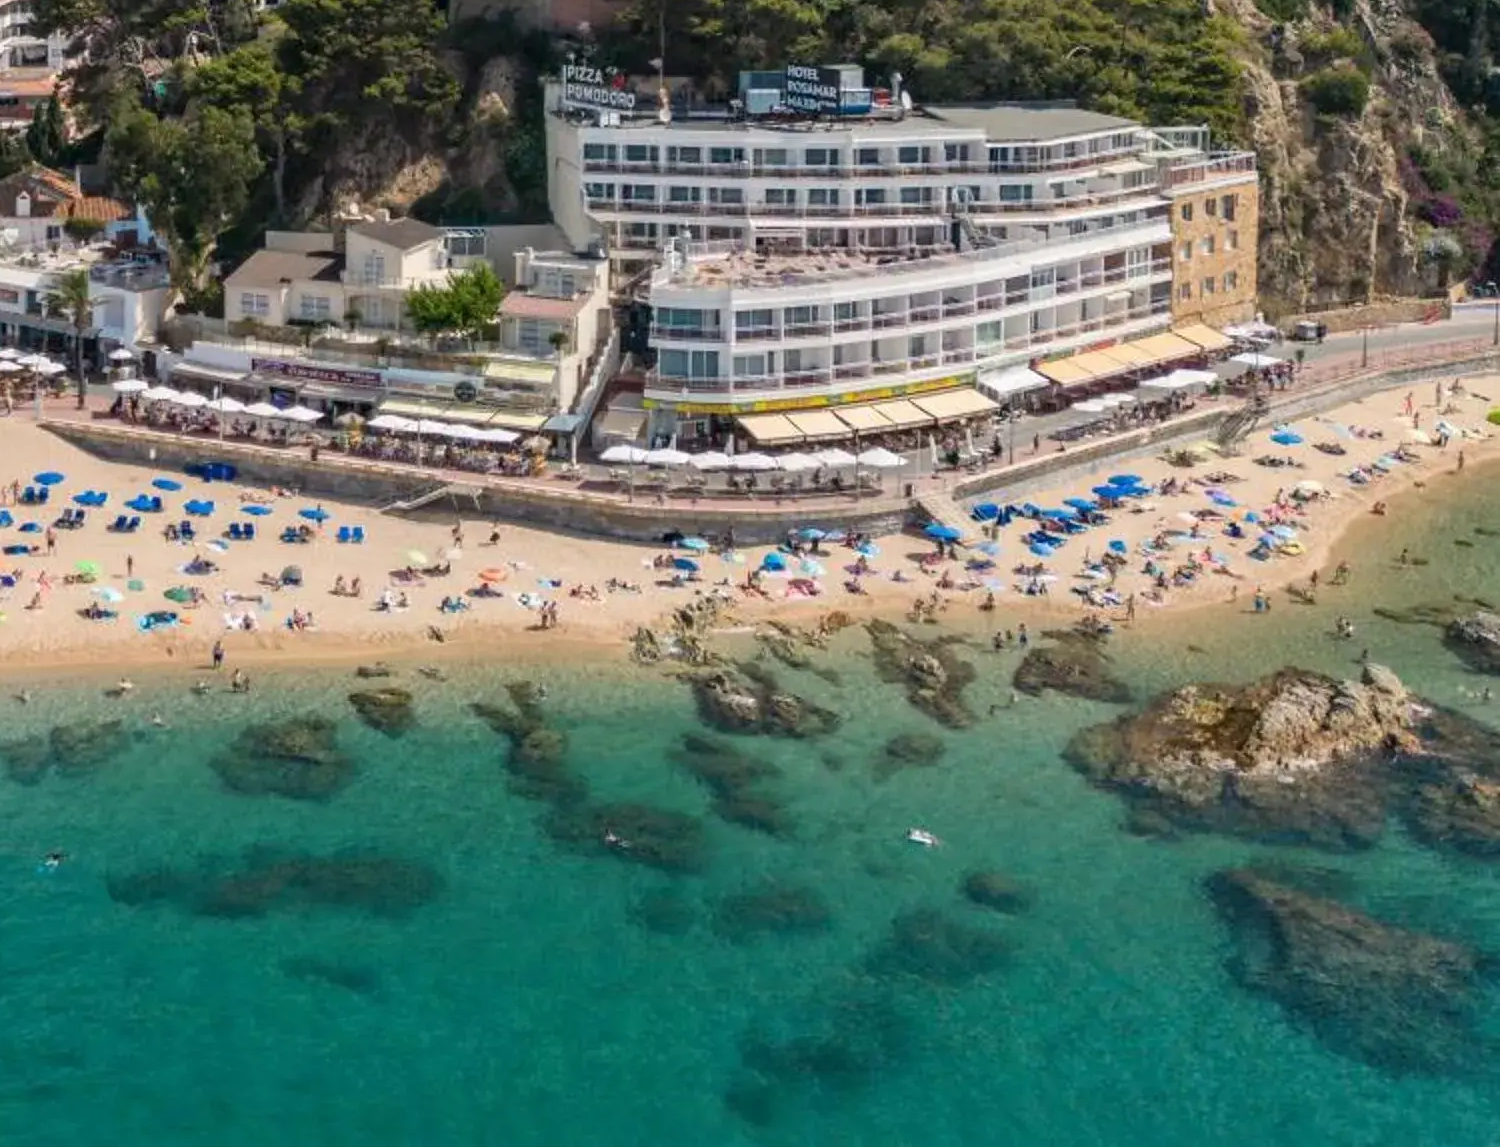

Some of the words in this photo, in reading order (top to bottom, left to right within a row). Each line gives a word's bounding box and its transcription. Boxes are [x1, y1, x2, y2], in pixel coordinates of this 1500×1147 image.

[567, 66, 603, 84] PIZZA
[787, 64, 820, 81] HOTEL
[567, 84, 636, 107] POMODORO
[787, 80, 837, 100] ROSAMAR
